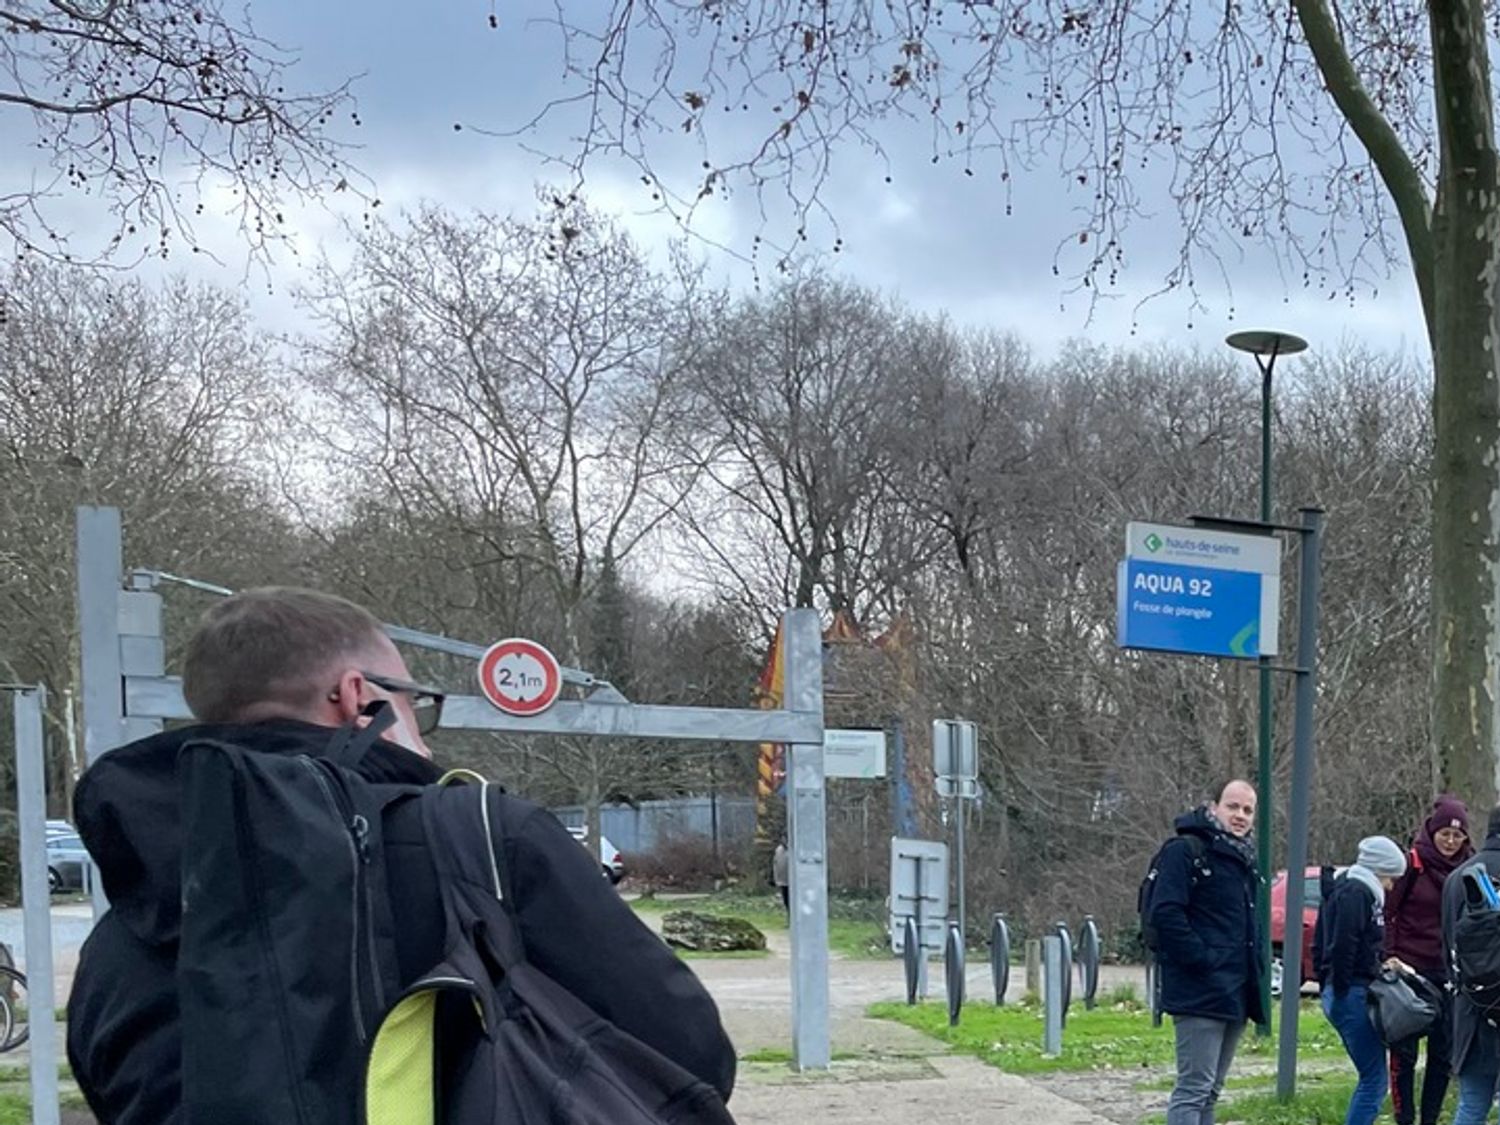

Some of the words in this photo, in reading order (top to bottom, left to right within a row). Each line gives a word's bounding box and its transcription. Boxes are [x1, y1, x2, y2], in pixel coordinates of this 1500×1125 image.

[1134, 572, 1184, 594] AQUA
[1189, 578, 1212, 597] 92
[1162, 604, 1175, 615] de
